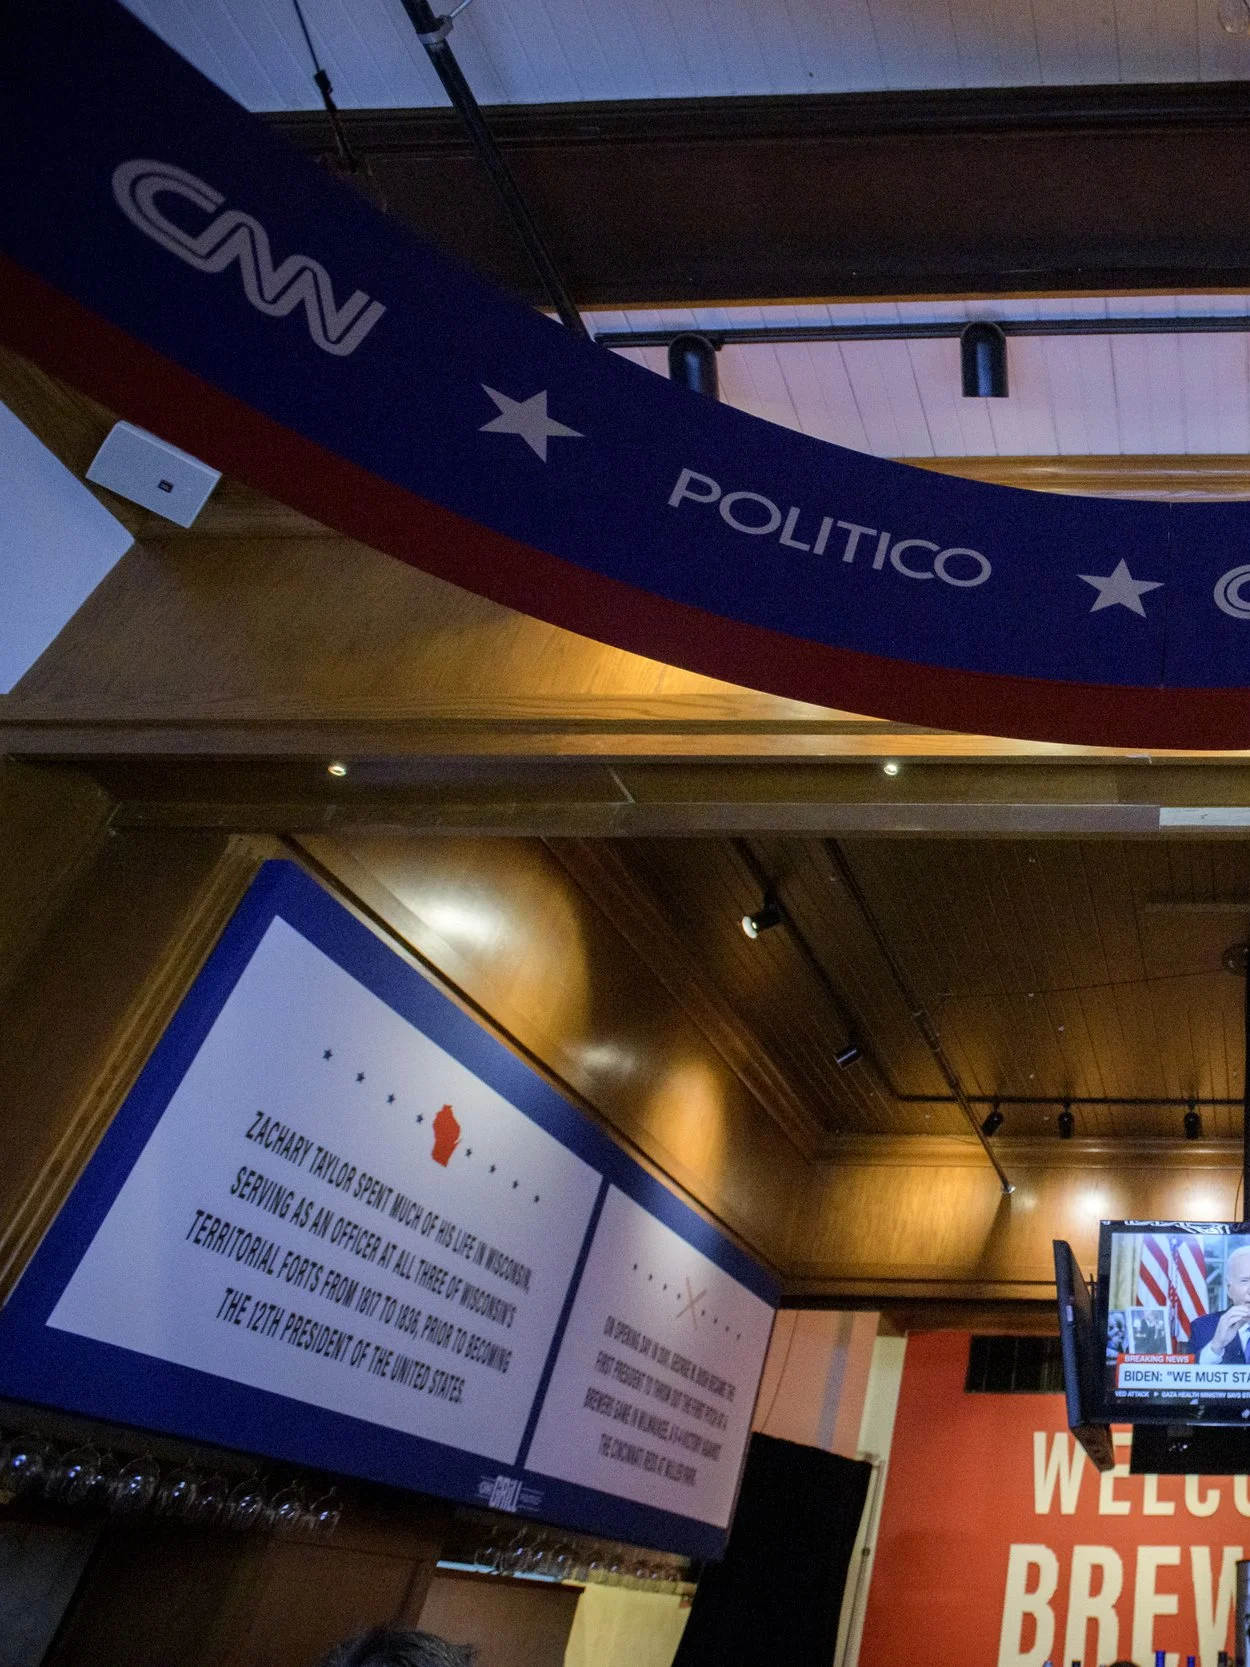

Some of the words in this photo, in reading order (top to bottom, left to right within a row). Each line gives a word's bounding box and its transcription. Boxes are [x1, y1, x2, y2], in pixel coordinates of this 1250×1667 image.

[111, 159, 386, 356] CNN
[668, 468, 992, 588] POLITICO
[230, 1166, 295, 1219] SERVING
[289, 1197, 314, 1228] AS
[309, 1207, 334, 1238] AN
[330, 1217, 382, 1262] OFFICER
[377, 1242, 398, 1268] AT
[392, 1249, 416, 1280] ALL
[414, 1259, 449, 1295] THREE
[445, 1275, 463, 1300] OF
[245, 1111, 314, 1166] ZACHARY
[309, 1146, 357, 1192] TAYLOR
[353, 1172, 394, 1212] SPENT
[389, 1193, 424, 1230] MUCH
[421, 1211, 440, 1237] OF
[435, 1220, 456, 1248] HIS
[452, 1229, 477, 1260] LIFE
[473, 1241, 487, 1266] IN
[186, 1209, 280, 1275] TERRITORIAL
[277, 1250, 324, 1293] FORTS
[320, 1269, 359, 1307] FROM
[355, 1286, 383, 1317] 1817
[379, 1295, 398, 1324] TO
[394, 1304, 422, 1339] 1836,
[420, 1314, 454, 1348] PRIOR
[451, 1327, 468, 1355] TO
[216, 1287, 252, 1325] THE
[246, 1301, 285, 1337] 12TH
[280, 1312, 354, 1362] PRESIDENT
[350, 1339, 371, 1368] OF
[368, 1345, 394, 1377] THE
[390, 1354, 431, 1391] UNITED
[1124, 1354, 1164, 1363] BREAKING
[1166, 1355, 1190, 1363] NEWS
[1124, 1370, 1163, 1382] BIDEN:
[1167, 1371, 1191, 1382] "WE
[1195, 1371, 1228, 1383] MUST
[1127, 1390, 1150, 1398] ATTACK
